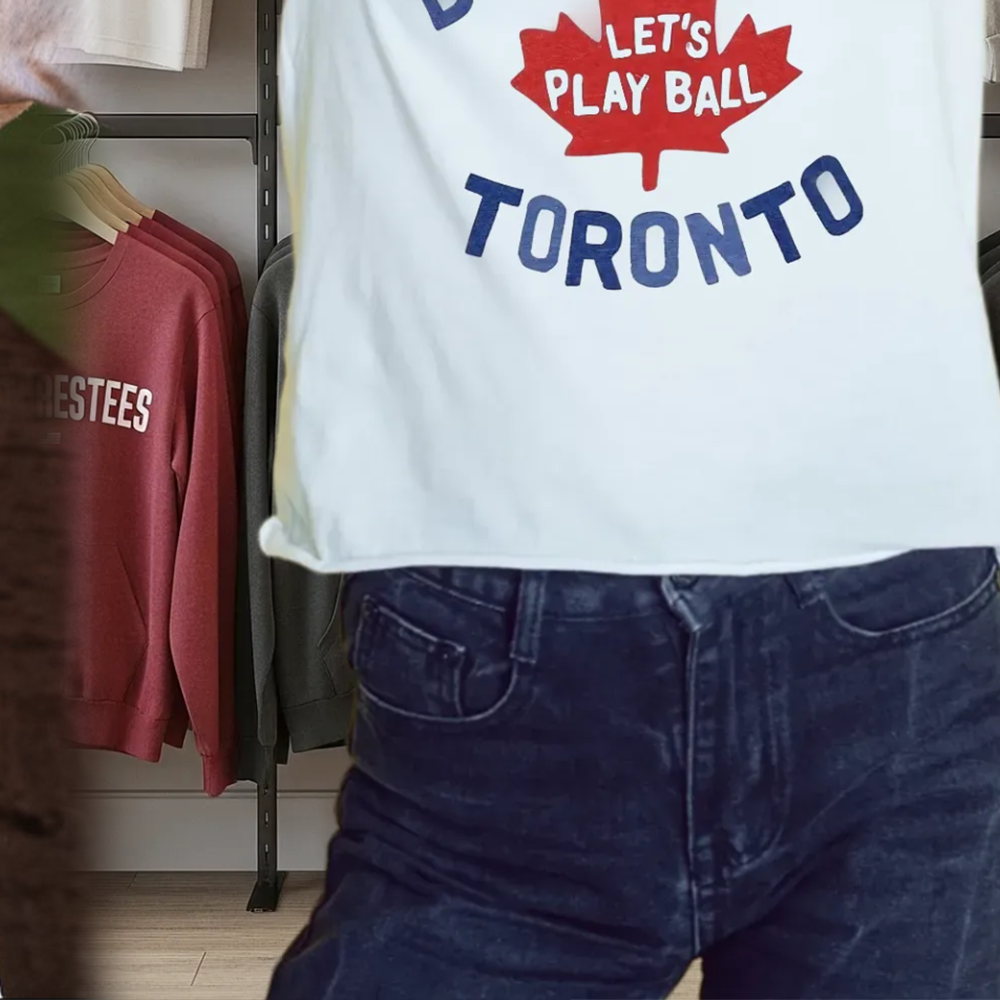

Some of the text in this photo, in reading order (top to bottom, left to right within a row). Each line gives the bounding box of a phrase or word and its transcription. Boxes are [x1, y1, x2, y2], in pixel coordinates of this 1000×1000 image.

[606, 13, 711, 59] LET'S
[544, 64, 767, 117] PLAY BALL
[464, 155, 864, 290] TORONTO
